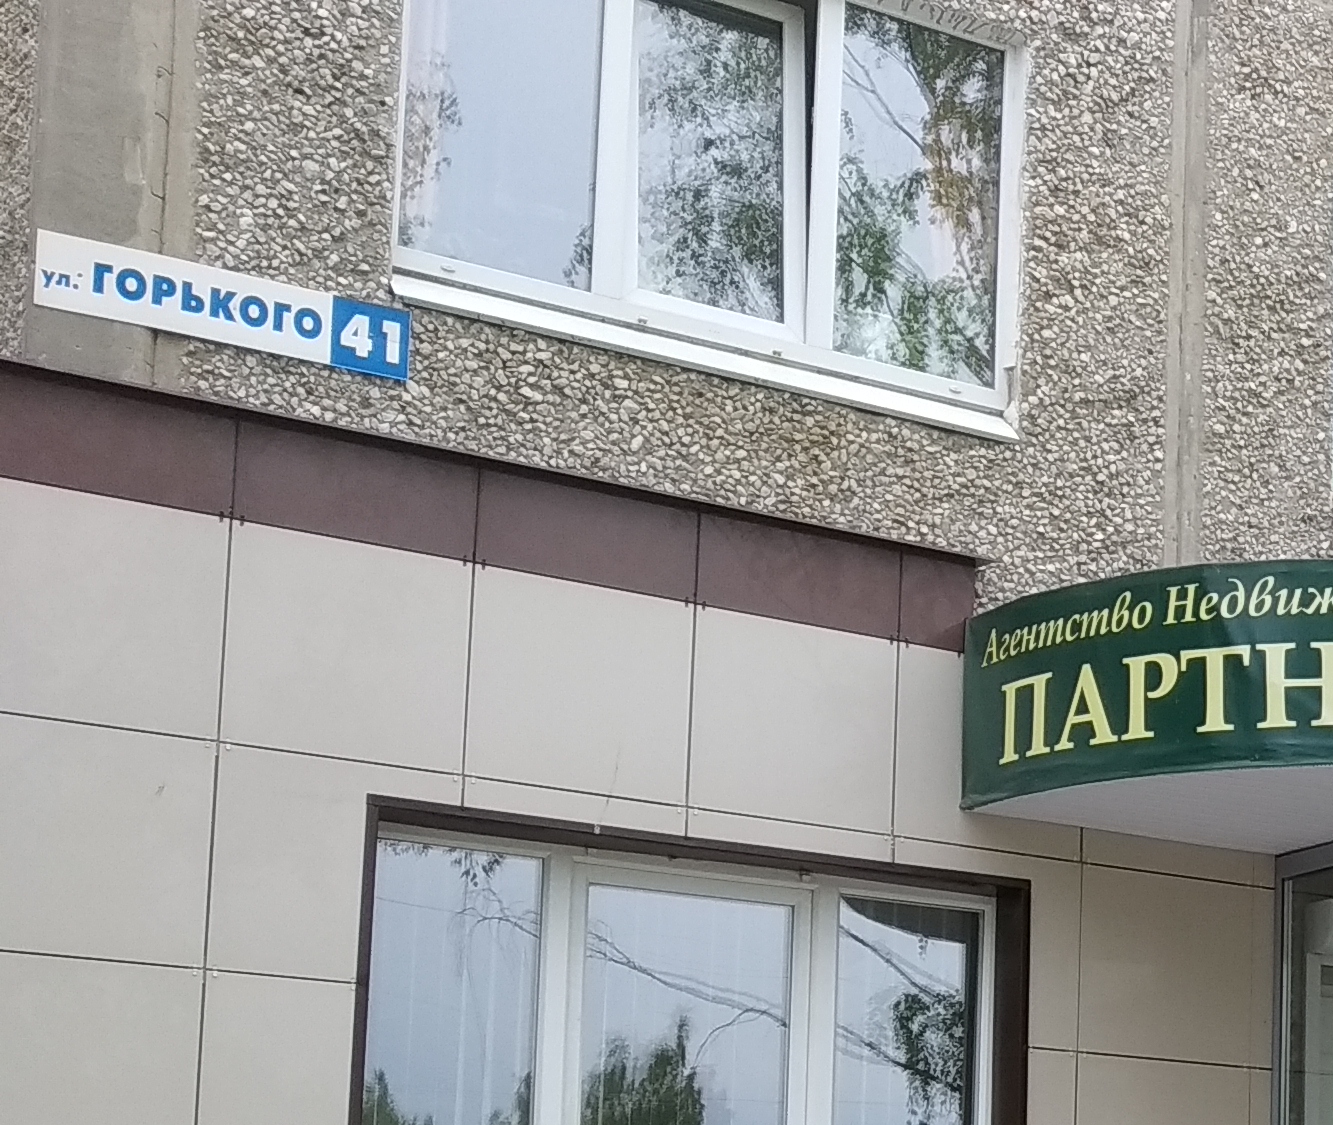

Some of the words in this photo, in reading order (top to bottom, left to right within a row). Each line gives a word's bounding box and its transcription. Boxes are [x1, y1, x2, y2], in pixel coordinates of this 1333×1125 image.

[92, 261, 323, 340] ГОРЬКОГО
[340, 313, 402, 366] 41
[981, 593, 1153, 668] Агентство
